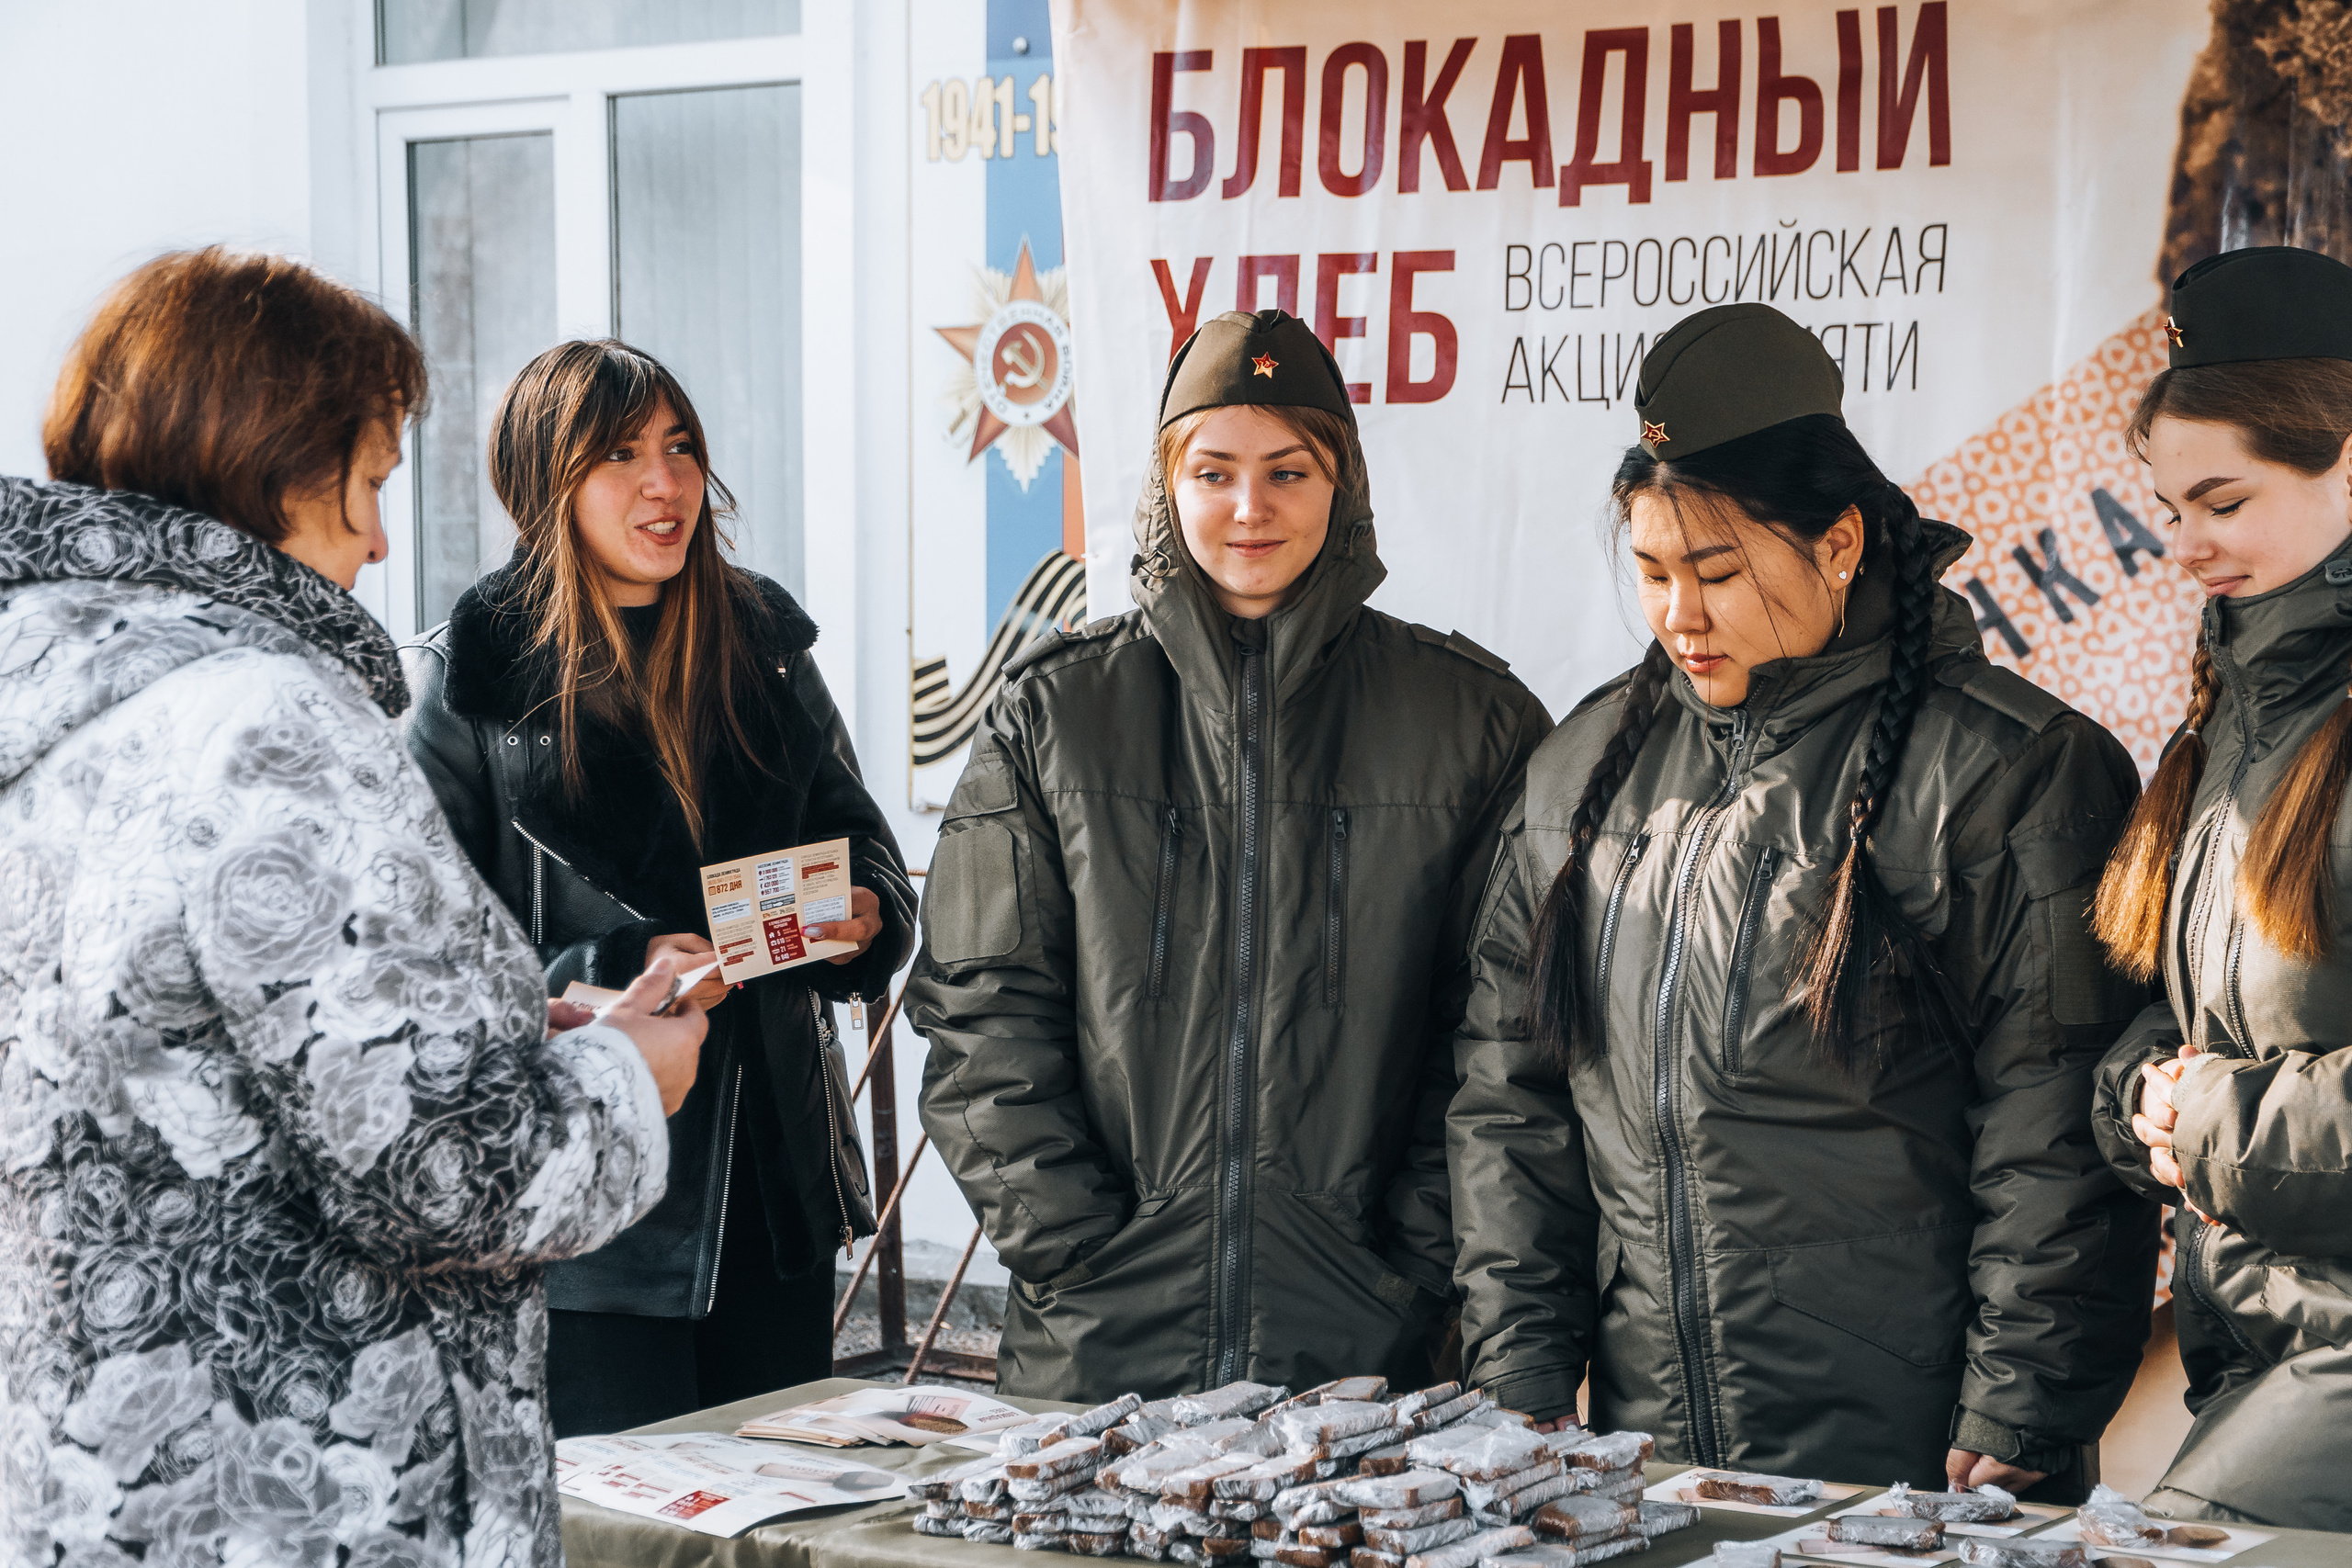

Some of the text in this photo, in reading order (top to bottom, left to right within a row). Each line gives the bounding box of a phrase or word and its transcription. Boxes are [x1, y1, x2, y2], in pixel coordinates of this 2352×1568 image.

[1505, 219, 1948, 312] ВСЕРОССИЙСКАЯ
[1501, 332, 1667, 410] АКЦИ
[716, 883, 729, 893] 872
[728, 879, 742, 891] ДНЯ
